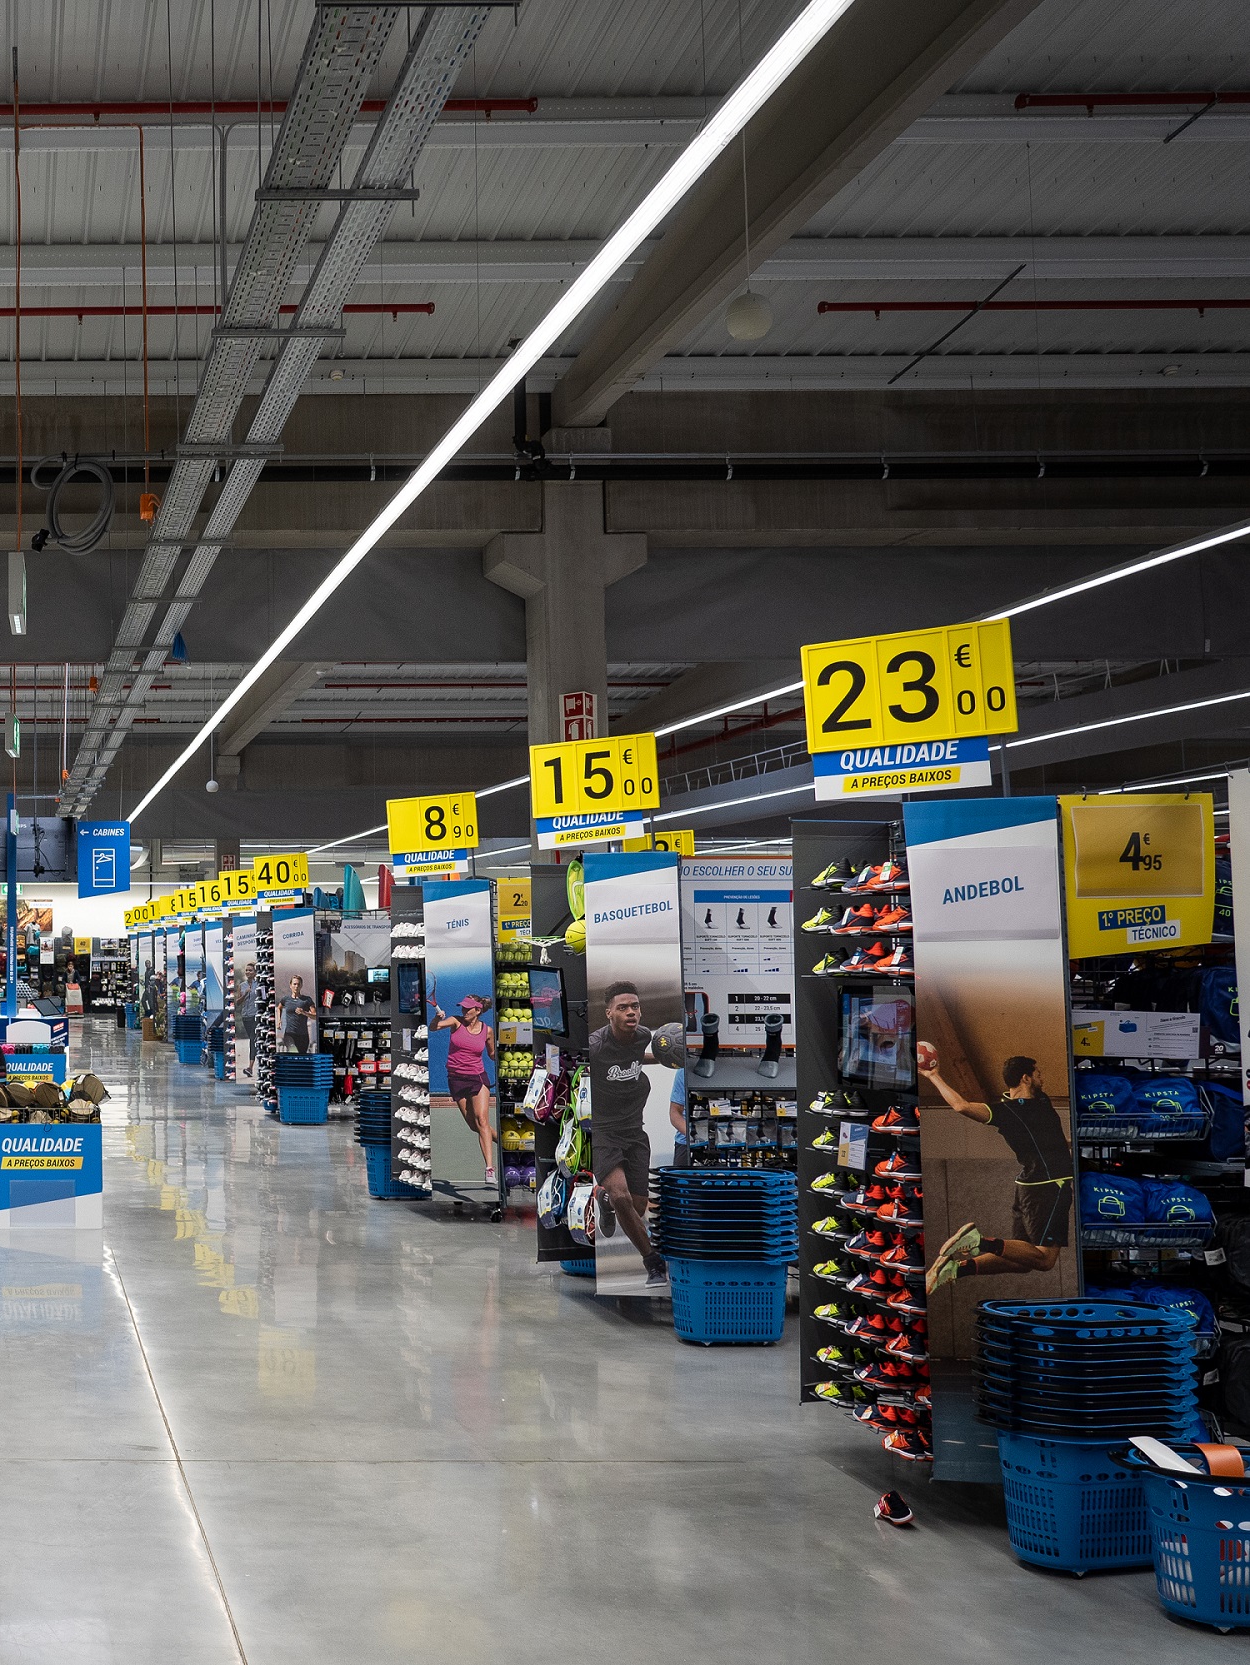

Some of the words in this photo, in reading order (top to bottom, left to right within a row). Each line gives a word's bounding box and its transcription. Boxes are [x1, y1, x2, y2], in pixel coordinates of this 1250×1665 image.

[954, 643, 972, 668] €
[816, 650, 940, 734] 23
[956, 686, 1006, 716] 00
[622, 748, 633, 766] €
[840, 740, 959, 771] QUALIDADE
[544, 750, 614, 804] 15
[851, 777, 859, 789] A
[862, 772, 906, 790] PREÇOS
[910, 768, 952, 784] BAIXOS
[623, 777, 653, 797] 00
[452, 803, 460, 816] €
[424, 805, 446, 842] 8
[552, 810, 624, 830] QUALIDADE
[92, 828, 125, 838] CABINES
[453, 824, 474, 839] 90
[560, 832, 566, 842] A
[567, 830, 592, 841] PREÇOS
[594, 826, 622, 838] BAIXOS
[1142, 832, 1151, 846] €
[404, 848, 456, 864] QUALIDADE
[1119, 832, 1143, 872] 4
[412, 864, 430, 874] PREÇOS
[432, 862, 452, 872] BAIXOS
[692, 866, 745, 876] ESCOLHER
[746, 866, 755, 876] O
[756, 866, 777, 876] SEU
[1142, 854, 1162, 872] 95
[258, 861, 290, 884] 40
[200, 886, 220, 902] 16
[224, 876, 248, 896] 15
[264, 889, 295, 897] QUALIDADE
[942, 875, 1024, 906] ANDEBOL
[178, 892, 196, 908] 15
[513, 893, 522, 906] 2
[594, 899, 673, 925] BASQUETEBOL
[1117, 906, 1162, 926] PREÇO
[1218, 908, 1231, 917] 40
[446, 916, 470, 930] TÉNIS
[282, 931, 304, 940] CORRIDA
[1132, 925, 1176, 941] TÉCNICO
[6, 1062, 54, 1072] QUALIDADE
[1080, 1092, 1114, 1100] KIPSTA
[1144, 1090, 1180, 1098] KIPSTA
[2, 1137, 84, 1152] QUALIDADE
[6, 1159, 13, 1168] A
[14, 1158, 44, 1170] PREÇOS
[46, 1157, 75, 1167] BAIXOS
[1094, 1186, 1124, 1196] KIPSTA
